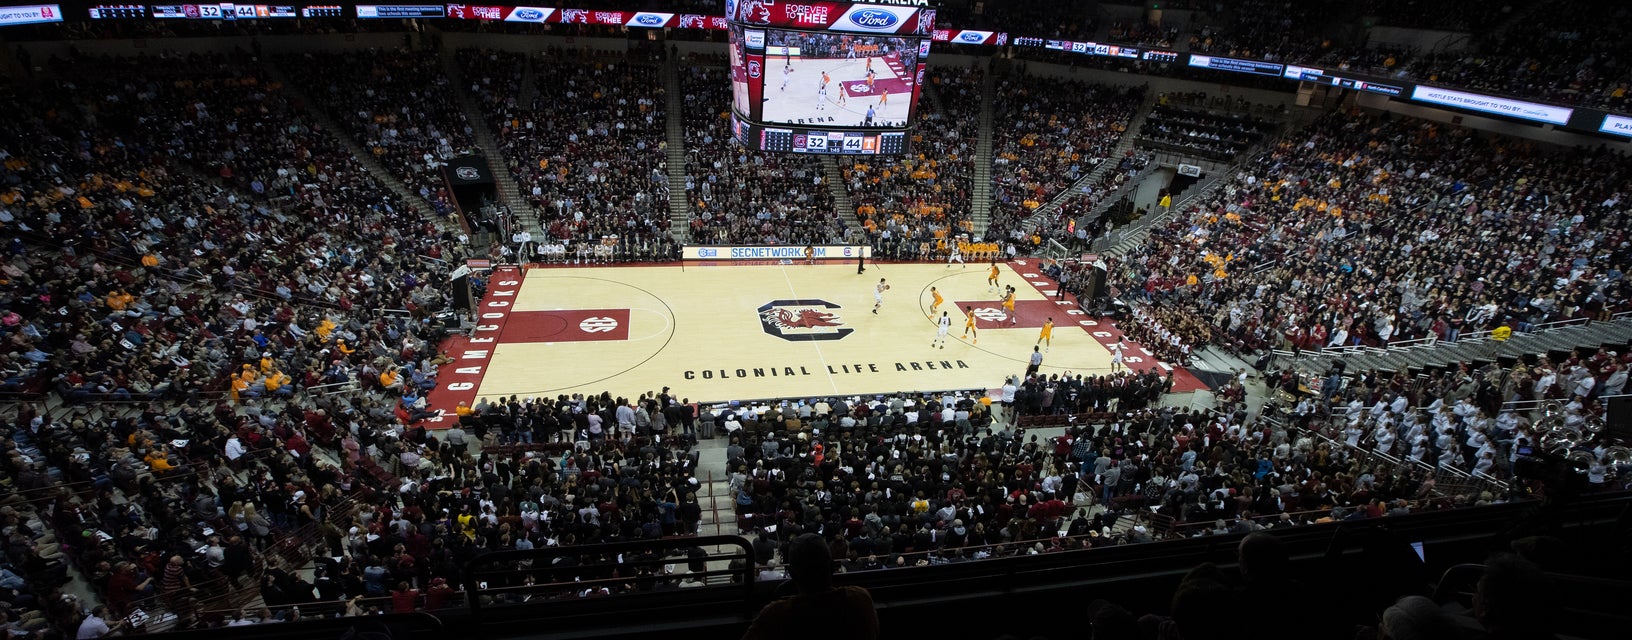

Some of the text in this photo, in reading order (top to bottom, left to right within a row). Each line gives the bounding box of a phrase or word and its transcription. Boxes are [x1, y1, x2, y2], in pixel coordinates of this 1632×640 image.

[202, 7, 218, 17] 32
[238, 7, 254, 17] 44
[786, 4, 828, 14] FOREVER
[520, 10, 538, 19] Ford
[640, 15, 658, 24] Ford
[797, 13, 827, 24] THEE
[859, 10, 888, 26] Ford
[1074, 43, 1085, 52] 32
[1096, 45, 1108, 54] 44
[1464, 98, 1490, 107] BROUGHT
[787, 116, 834, 124] ARENA
[809, 137, 824, 148] 32
[846, 138, 860, 149] 44
[732, 247, 826, 258] SECNETWORK.M
[447, 280, 519, 391] GAMECOCKS
[684, 359, 969, 380] COLONIAL LIFE ARENA
